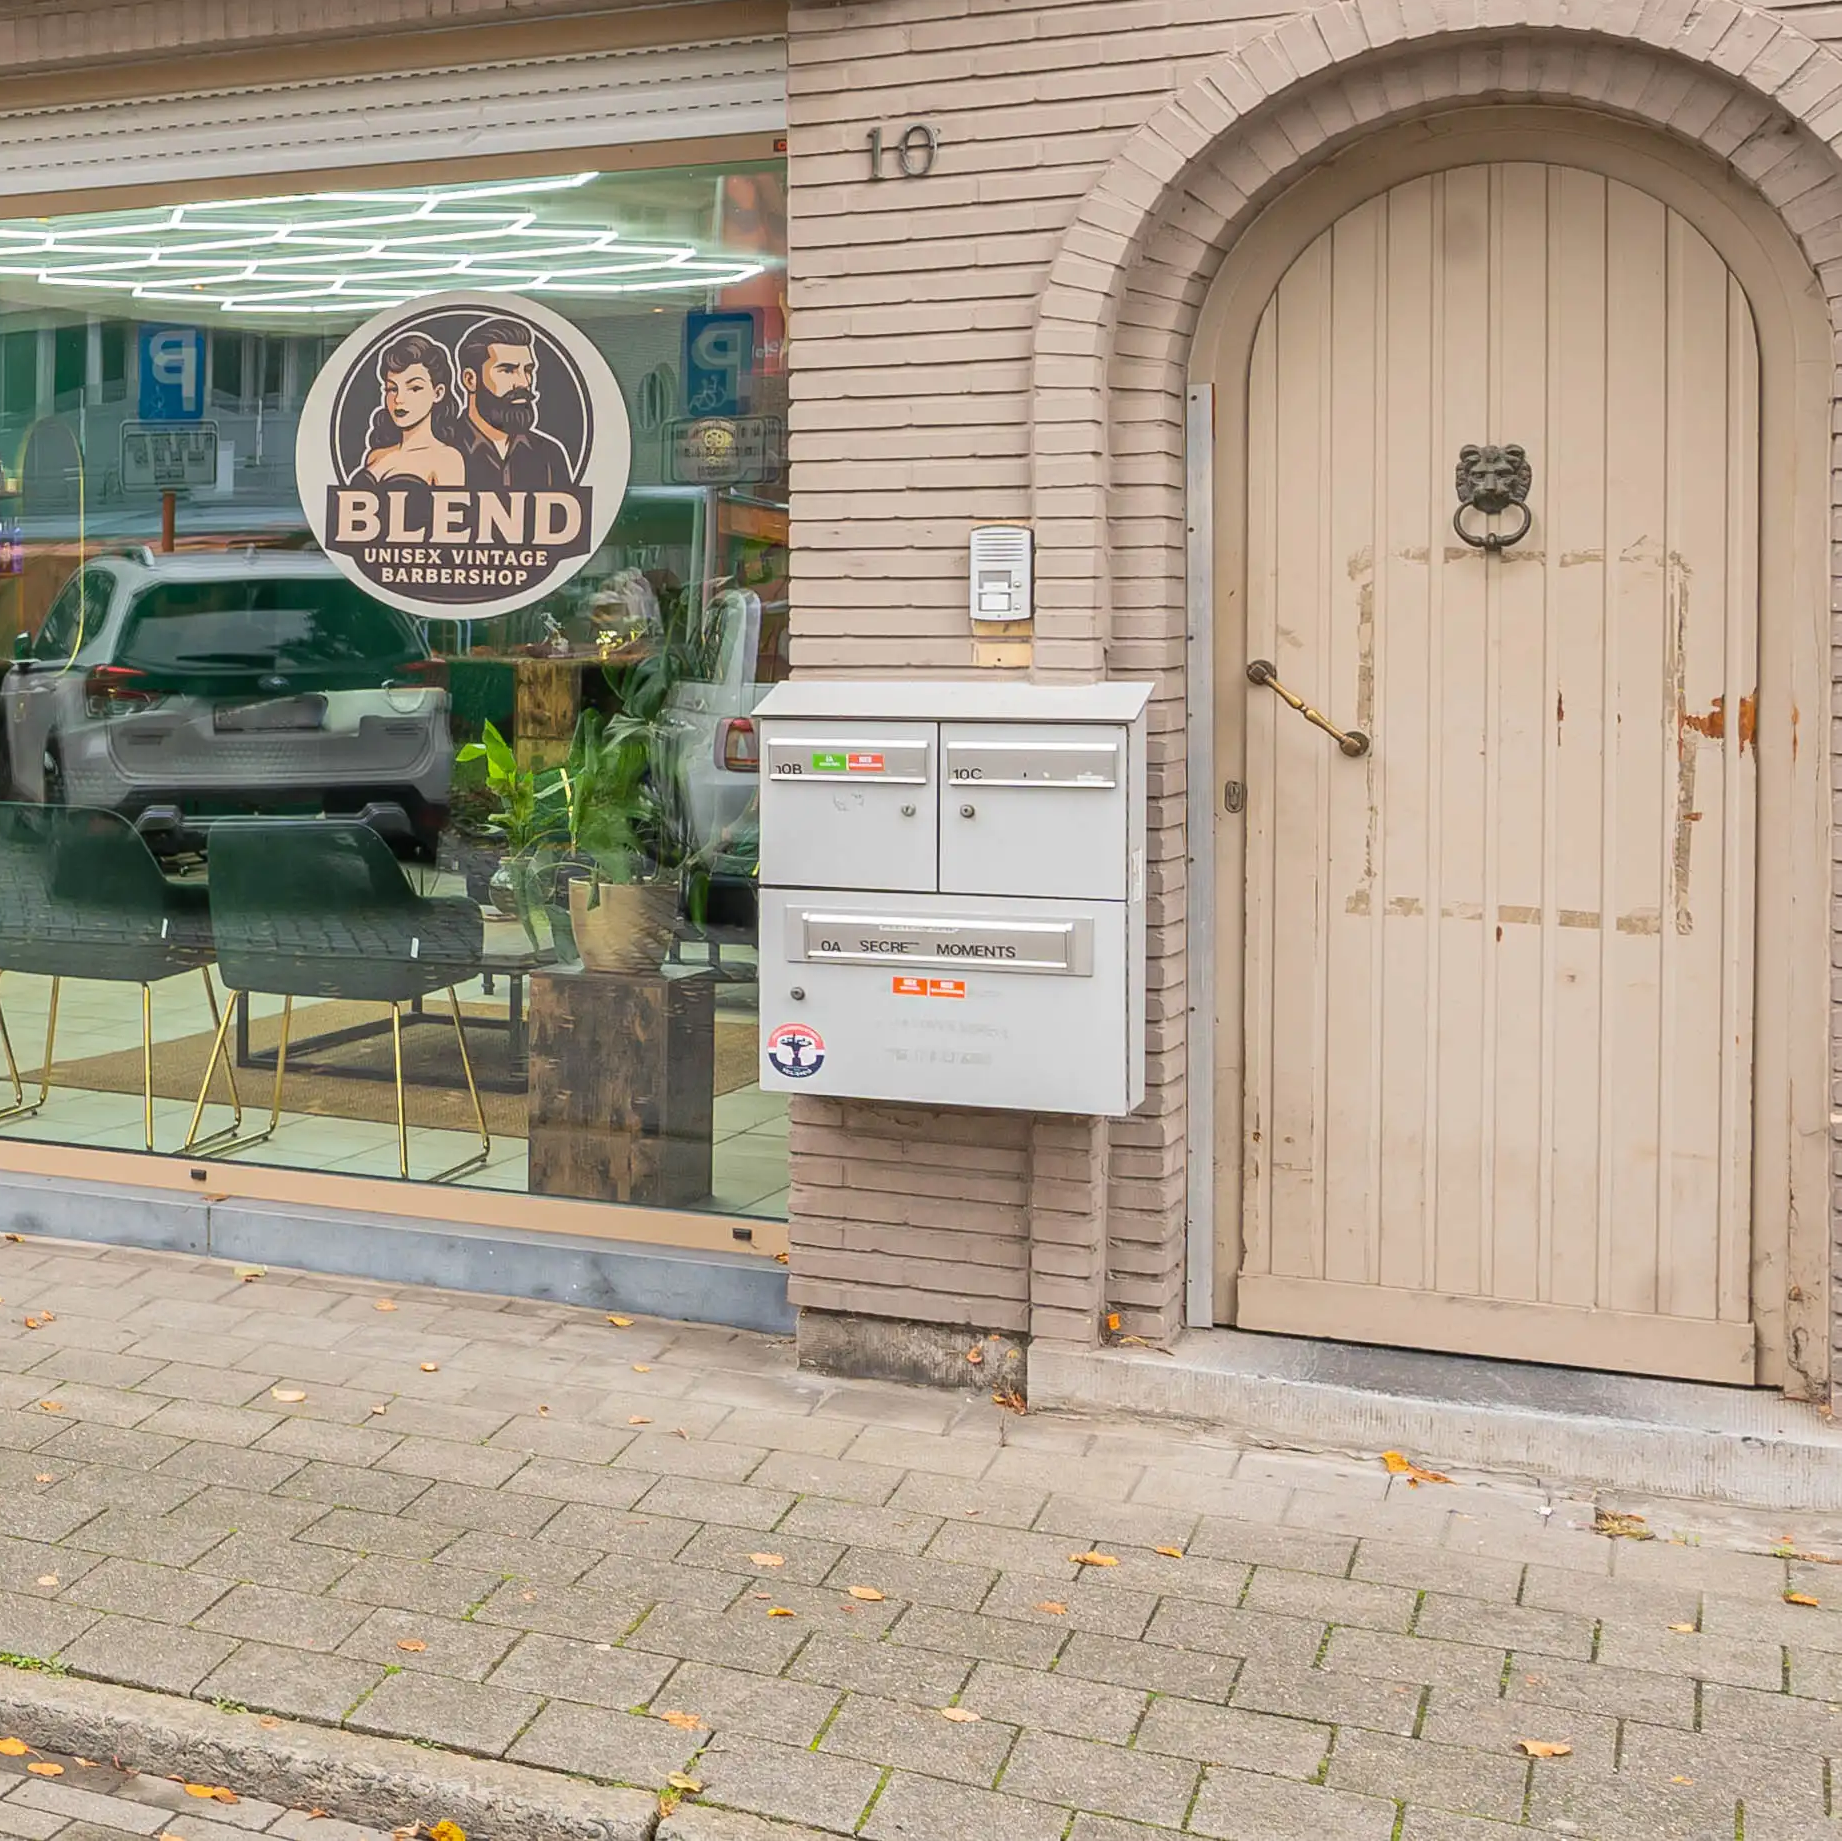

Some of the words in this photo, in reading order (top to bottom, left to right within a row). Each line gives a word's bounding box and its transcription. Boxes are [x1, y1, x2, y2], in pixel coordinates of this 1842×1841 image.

[866, 124, 938, 179] 10
[334, 490, 583, 546] BLEND
[364, 547, 442, 564] UNISEX
[451, 549, 549, 567] VINTAGE
[381, 567, 528, 586] BARBERSHOP
[953, 768, 983, 780] 10C
[935, 944, 1016, 958] MOMENTS
